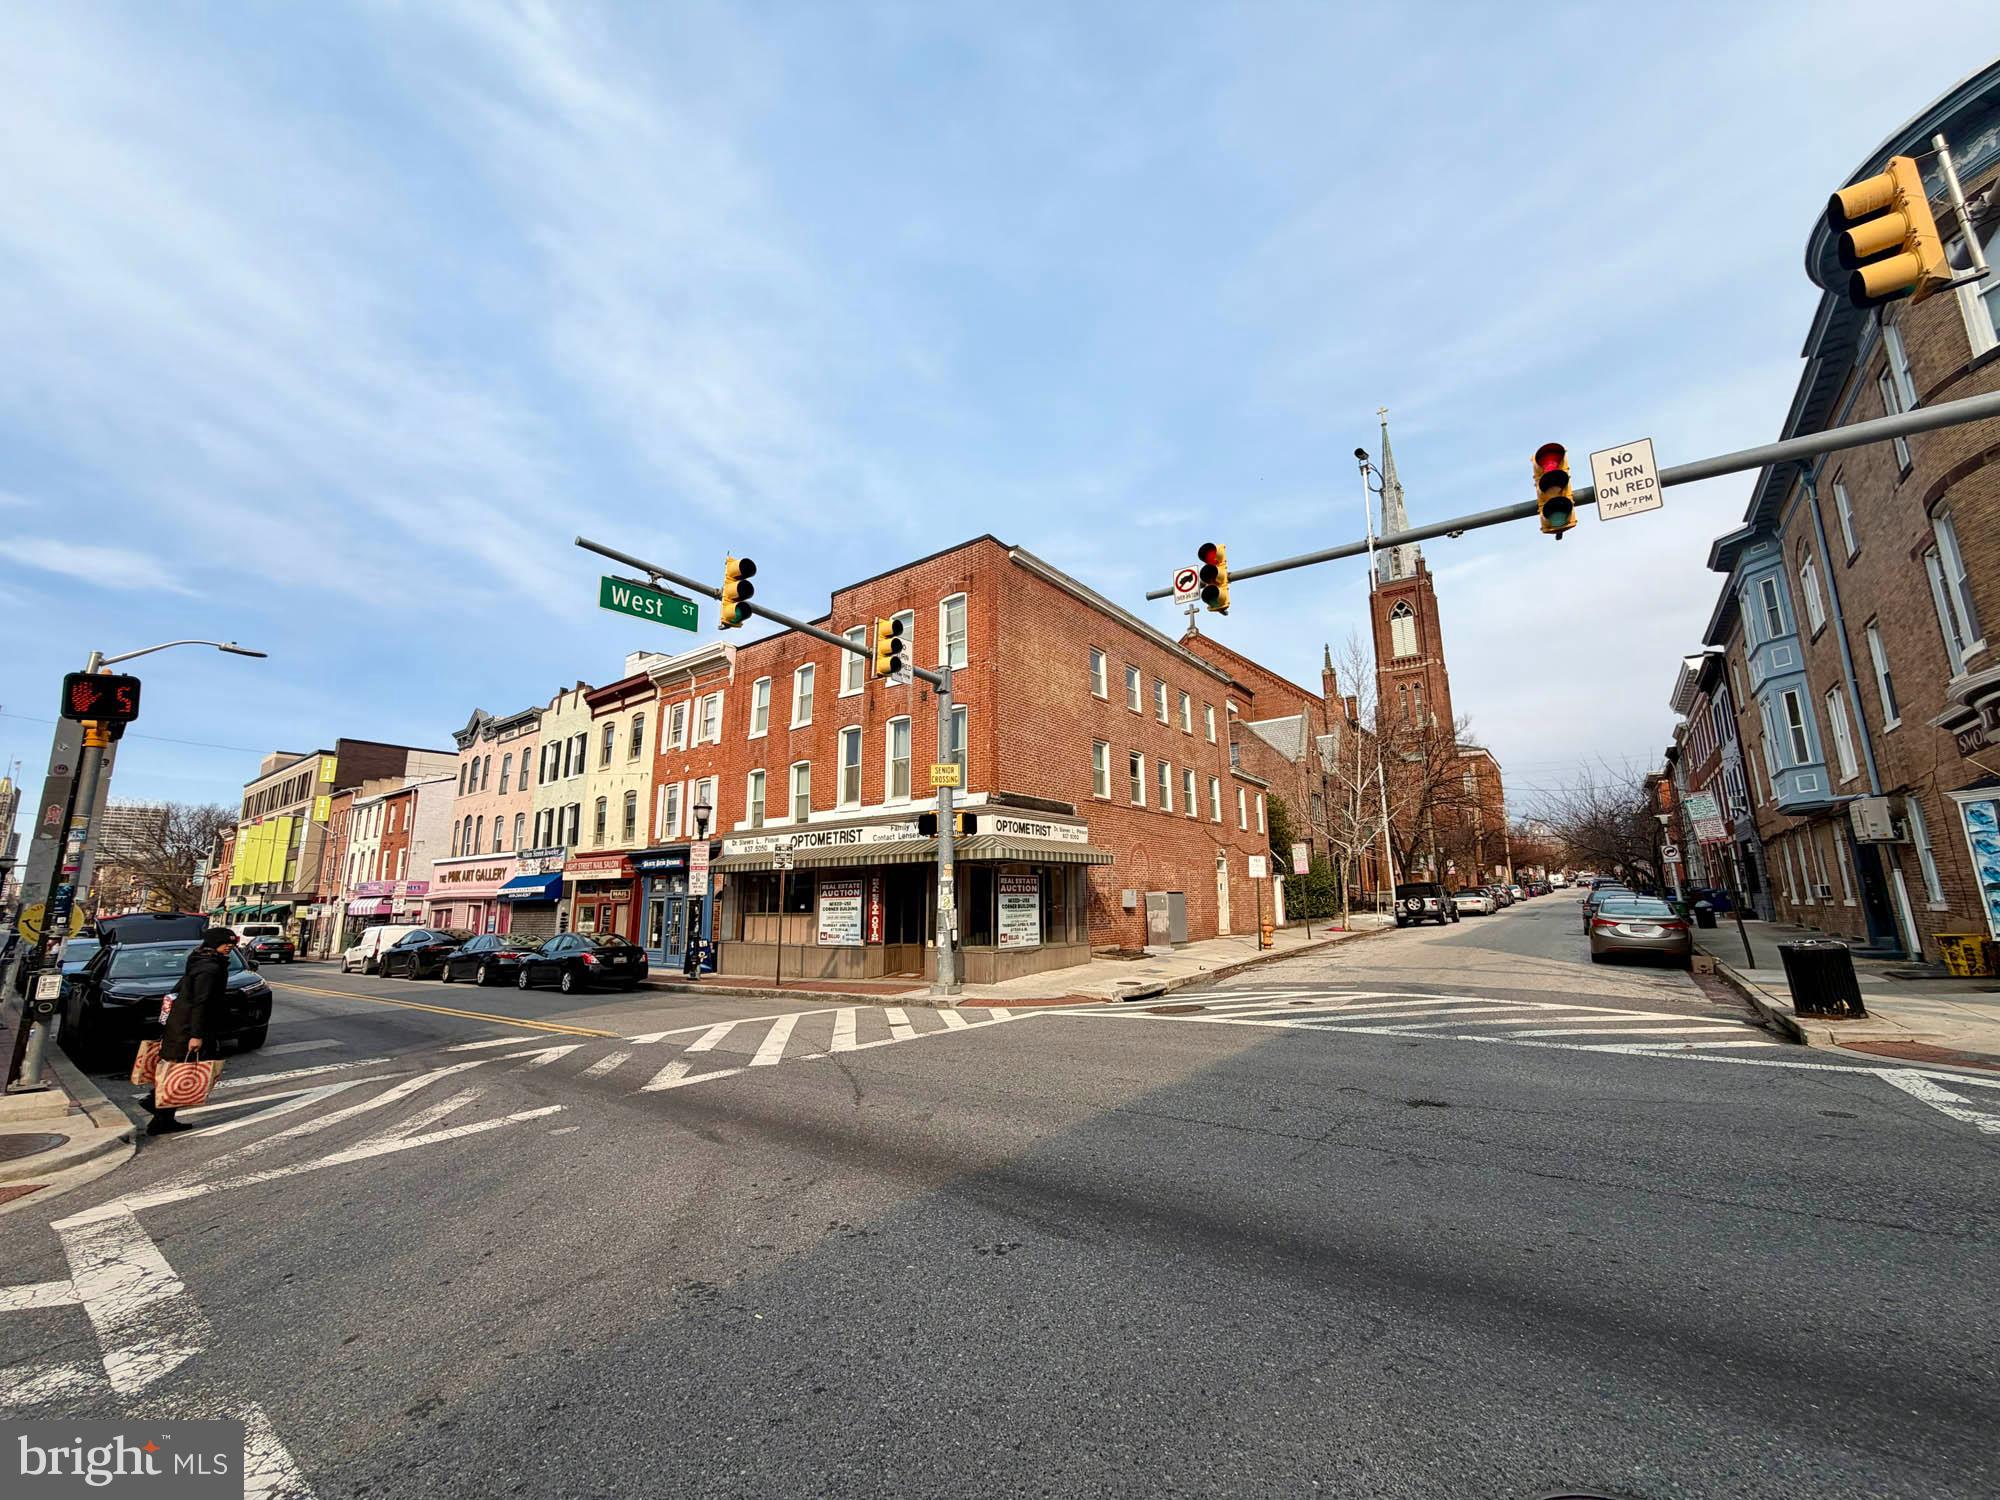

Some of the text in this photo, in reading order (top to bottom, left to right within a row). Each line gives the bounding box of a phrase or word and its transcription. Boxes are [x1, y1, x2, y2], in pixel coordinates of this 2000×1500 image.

[1610, 452, 1633, 467] NO
[1606, 465, 1643, 482] TURN
[1600, 478, 1655, 499] ON RED
[1606, 494, 1653, 511] 7AM-7PM
[611, 585, 694, 617] West ST
[116, 687, 132, 712] 5
[934, 766, 955, 774] SENIOR
[872, 831, 920, 841] Contact Lenses
[890, 823, 910, 832] Family
[995, 819, 1051, 837] OPTOMETRIST
[790, 829, 863, 848] OPTOMETRIST
[578, 862, 592, 870] STREET
[592, 861, 603, 869] NAIL
[603, 860, 619, 868] SALON
[439, 867, 507, 883] THE PINK ART GALLERY
